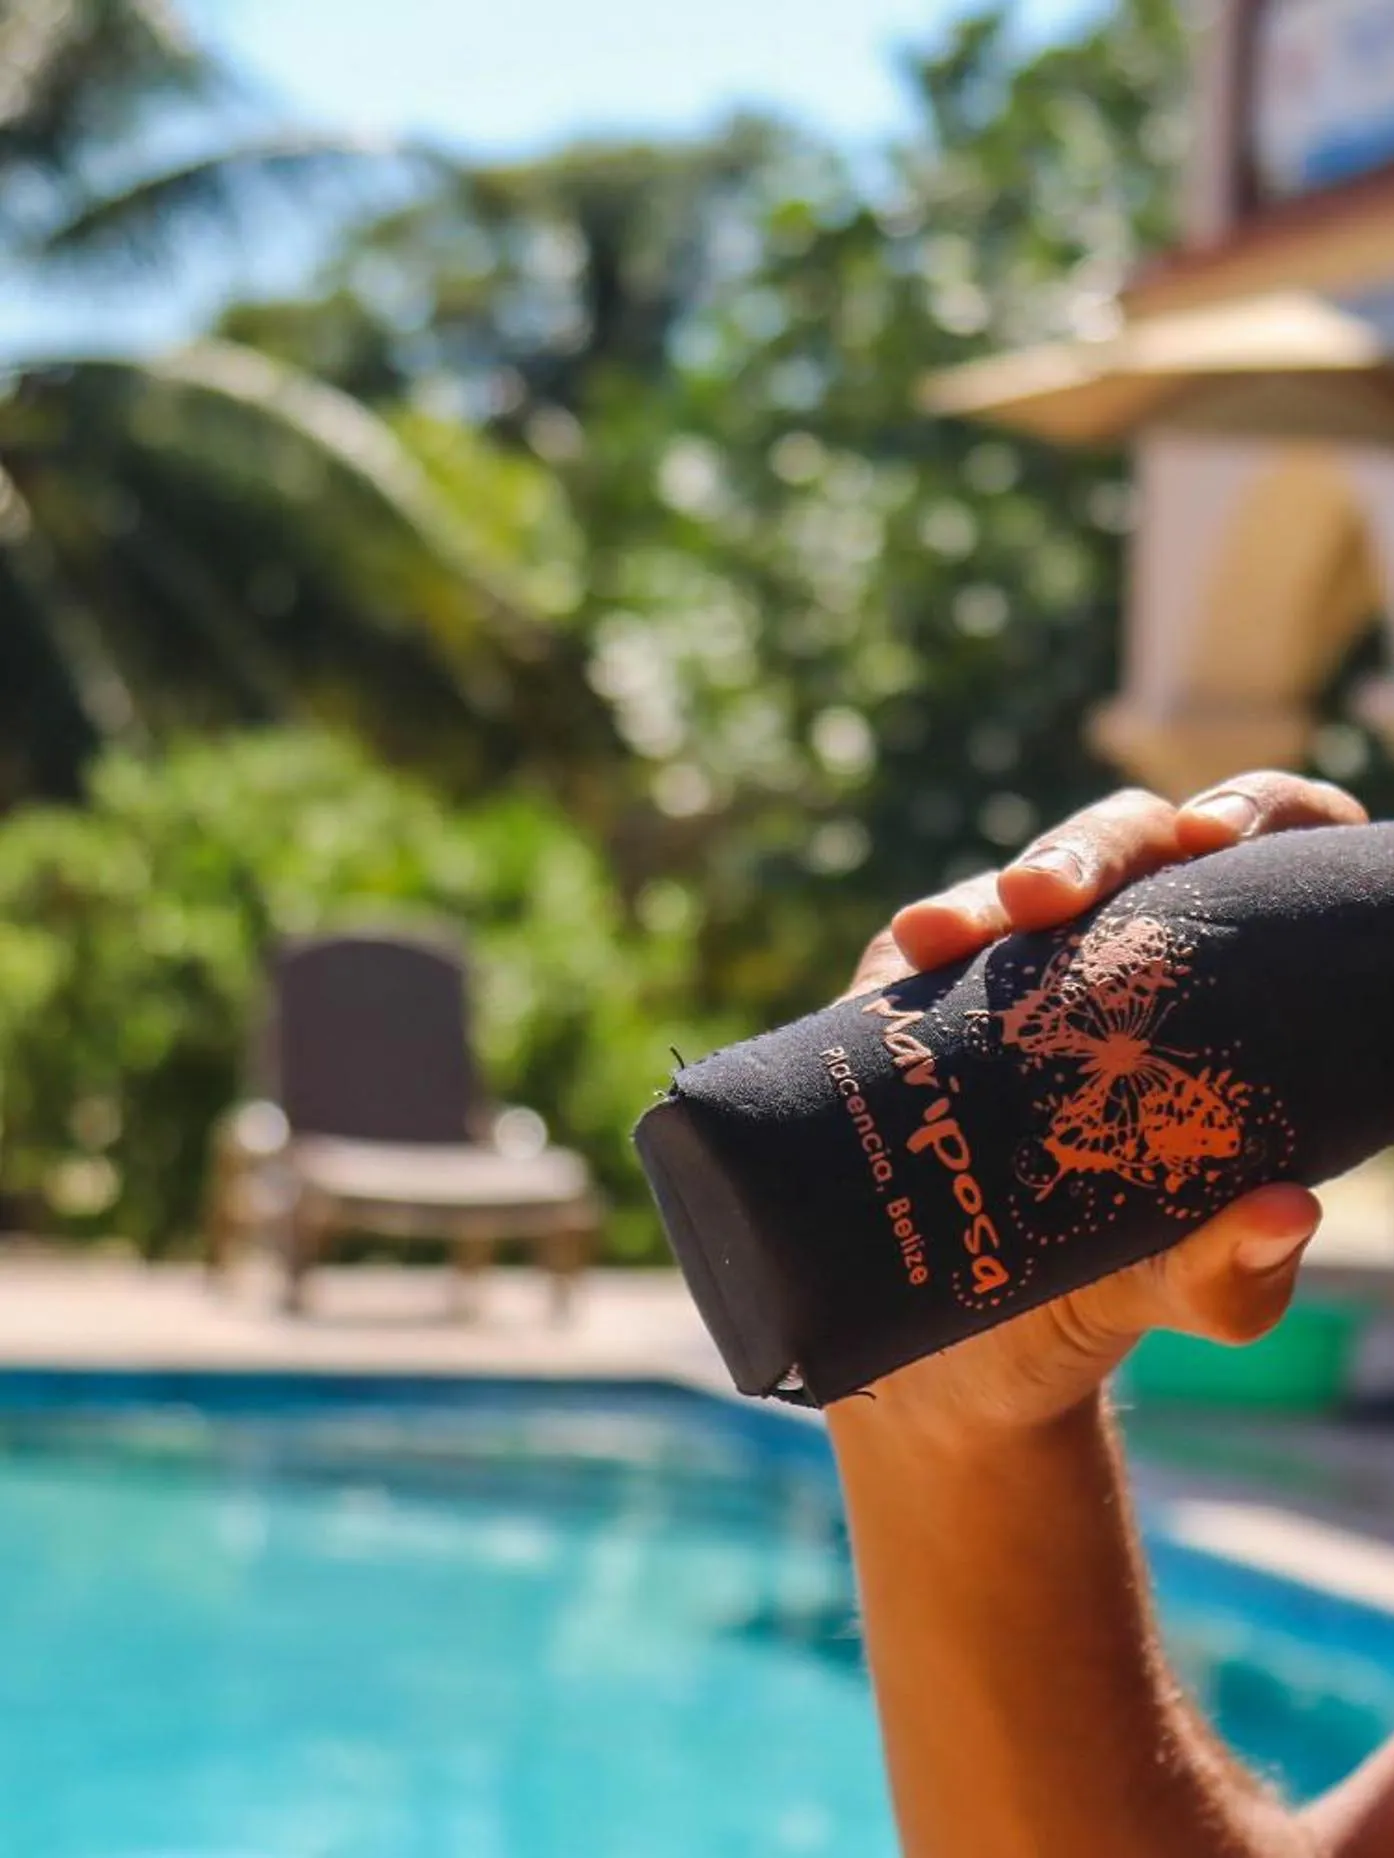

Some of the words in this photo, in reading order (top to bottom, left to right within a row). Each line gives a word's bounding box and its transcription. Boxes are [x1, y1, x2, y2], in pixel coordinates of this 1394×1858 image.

[819, 1045, 894, 1193] Placencia,
[886, 1197, 928, 1285] Belize
[861, 995, 1010, 1294] Mariposa
